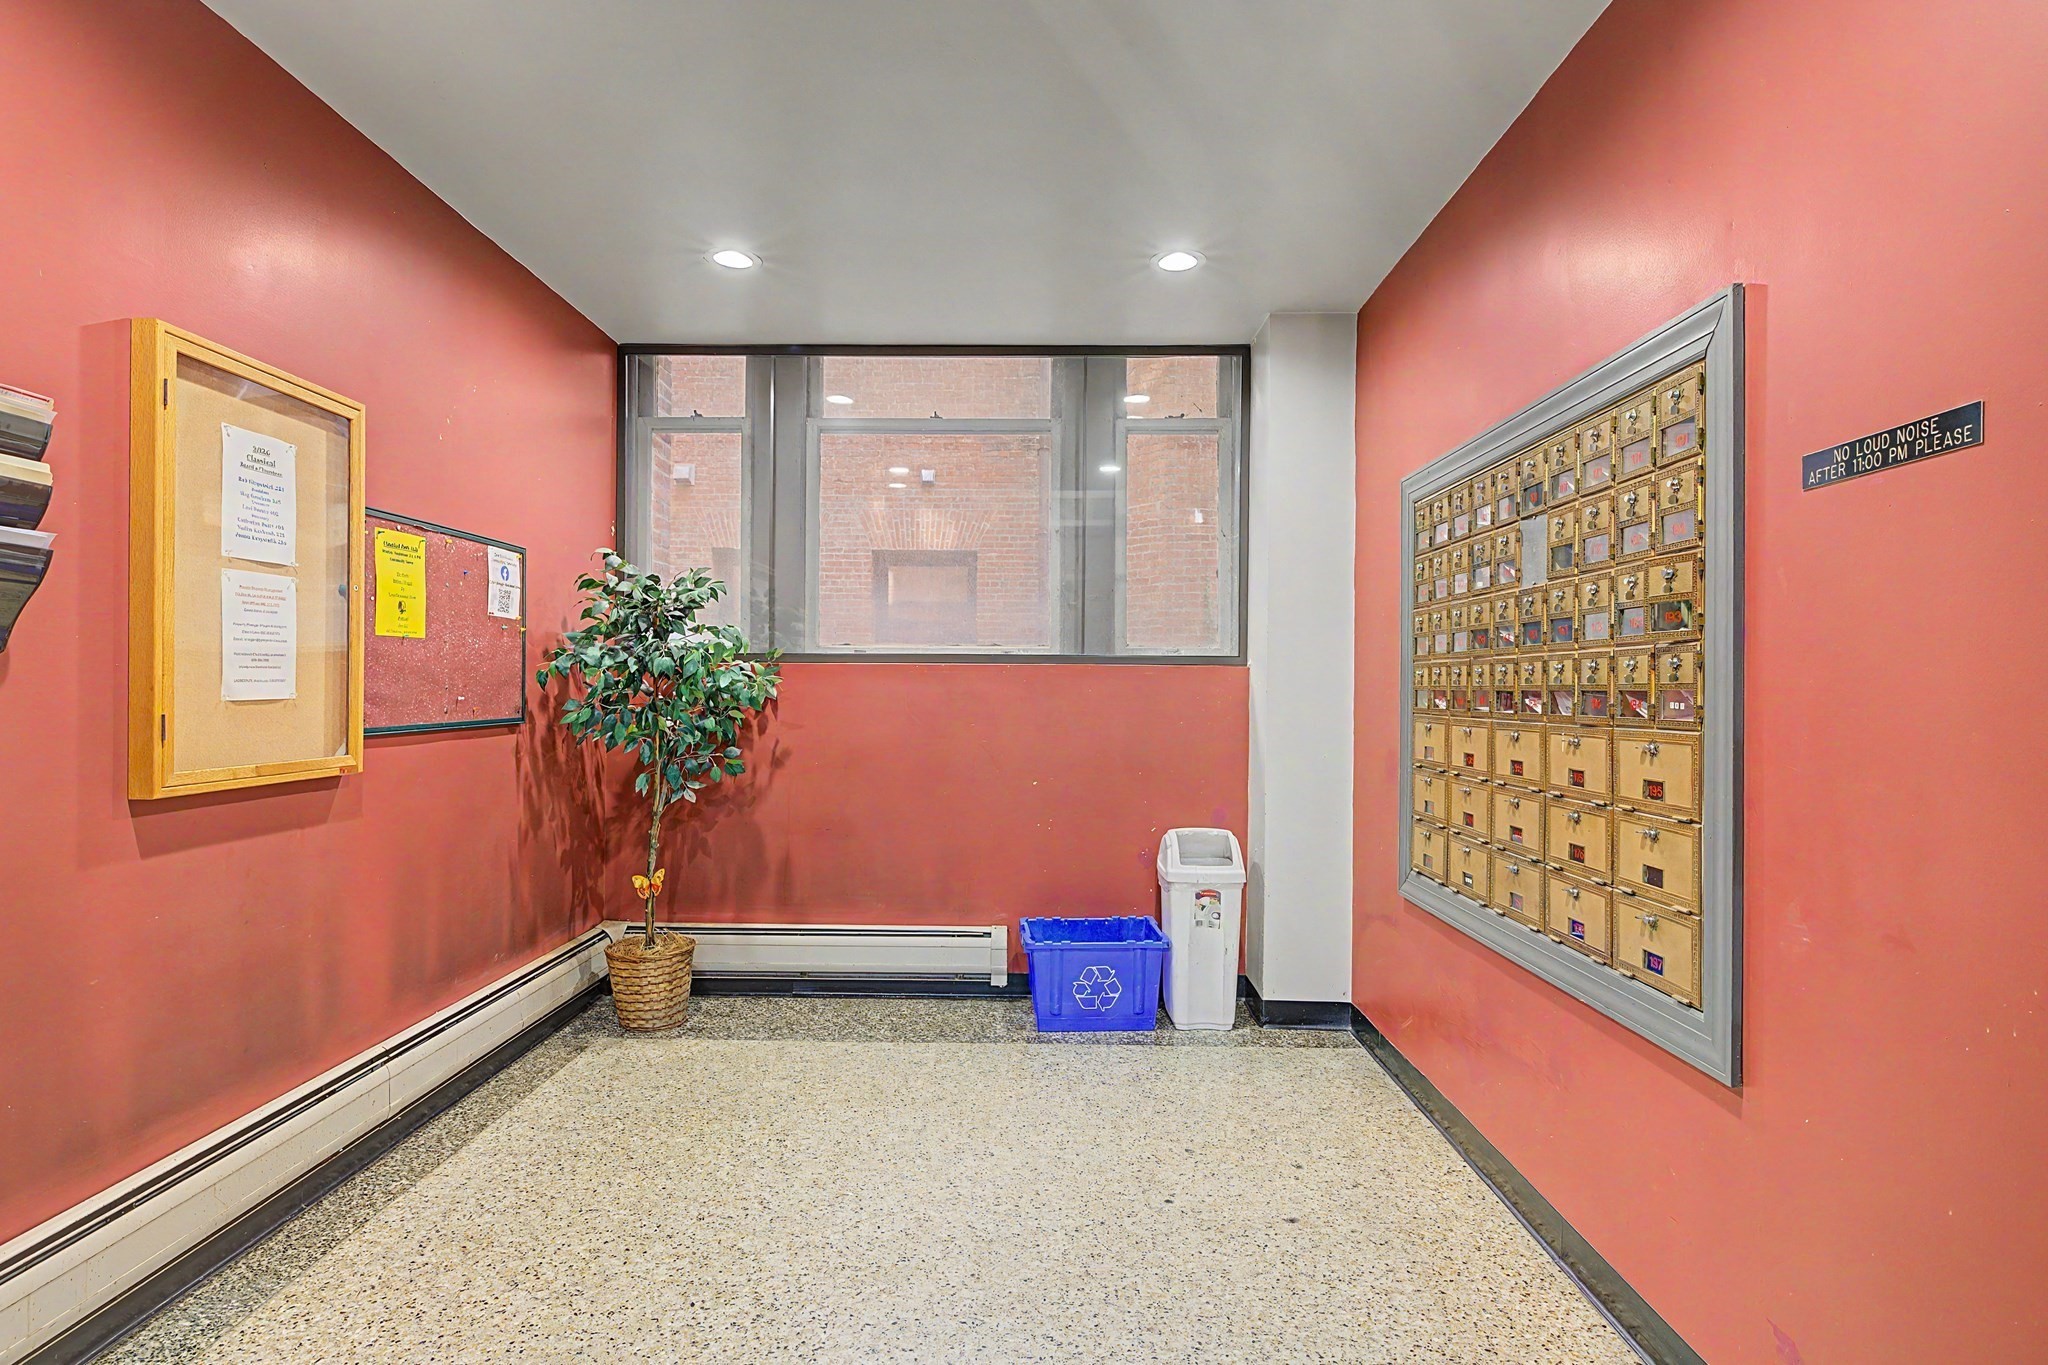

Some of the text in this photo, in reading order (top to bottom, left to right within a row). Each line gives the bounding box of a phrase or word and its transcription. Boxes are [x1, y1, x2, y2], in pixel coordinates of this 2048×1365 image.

[1833, 417, 1939, 463] NO LOUD NOISE
[1808, 424, 1973, 486] AFTER 11:00 PM PLEASE
[1665, 610, 1683, 624] 193
[1648, 785, 1663, 797] 195
[1649, 956, 1663, 975] 197
